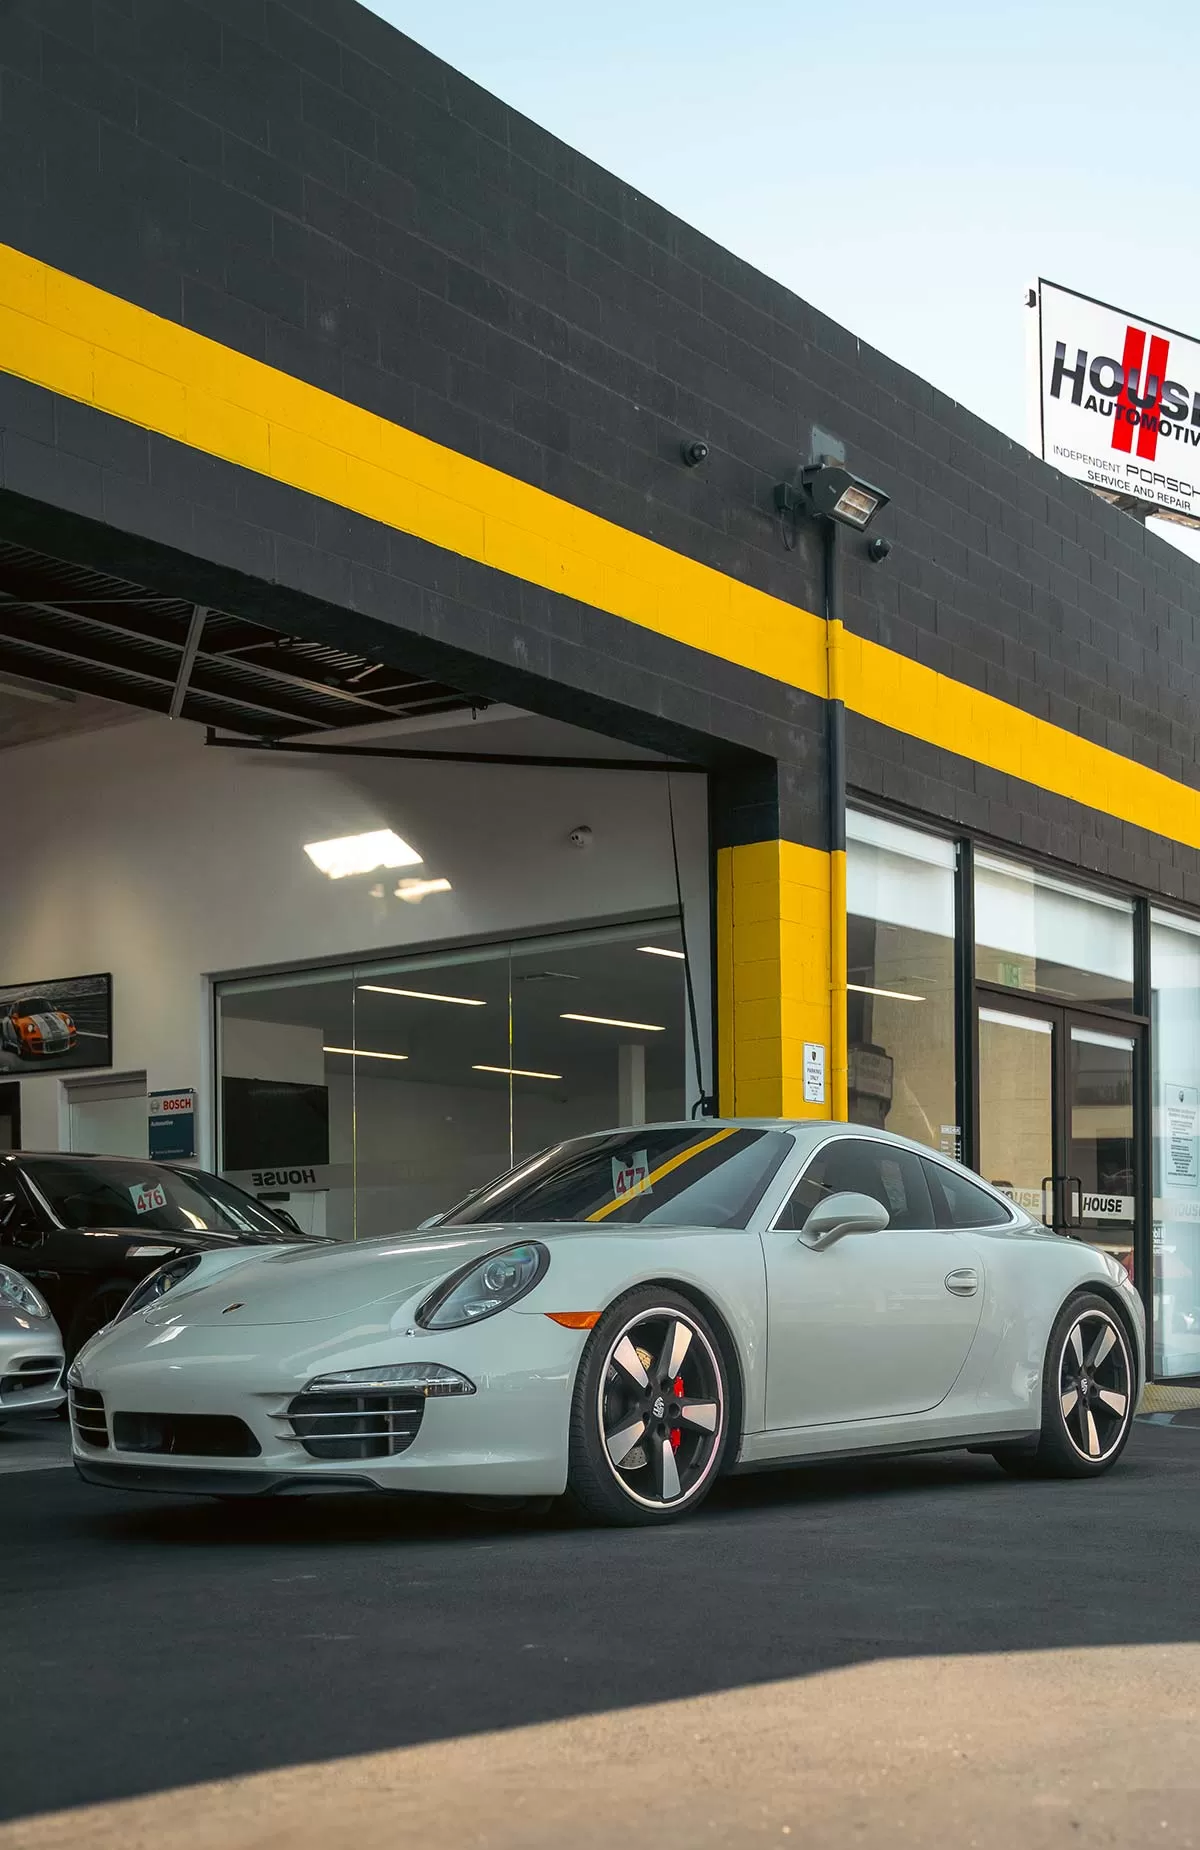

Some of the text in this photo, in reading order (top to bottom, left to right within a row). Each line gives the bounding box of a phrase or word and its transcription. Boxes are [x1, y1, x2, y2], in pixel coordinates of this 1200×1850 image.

[1053, 445, 1121, 474] INDEPENDENT
[1087, 470, 1191, 511] SERVICE AND REPAIR
[163, 1099, 191, 1111] BOSCH
[616, 1167, 645, 1193] 477
[137, 1190, 163, 1210] 476
[1083, 1197, 1122, 1212] HOUSE
